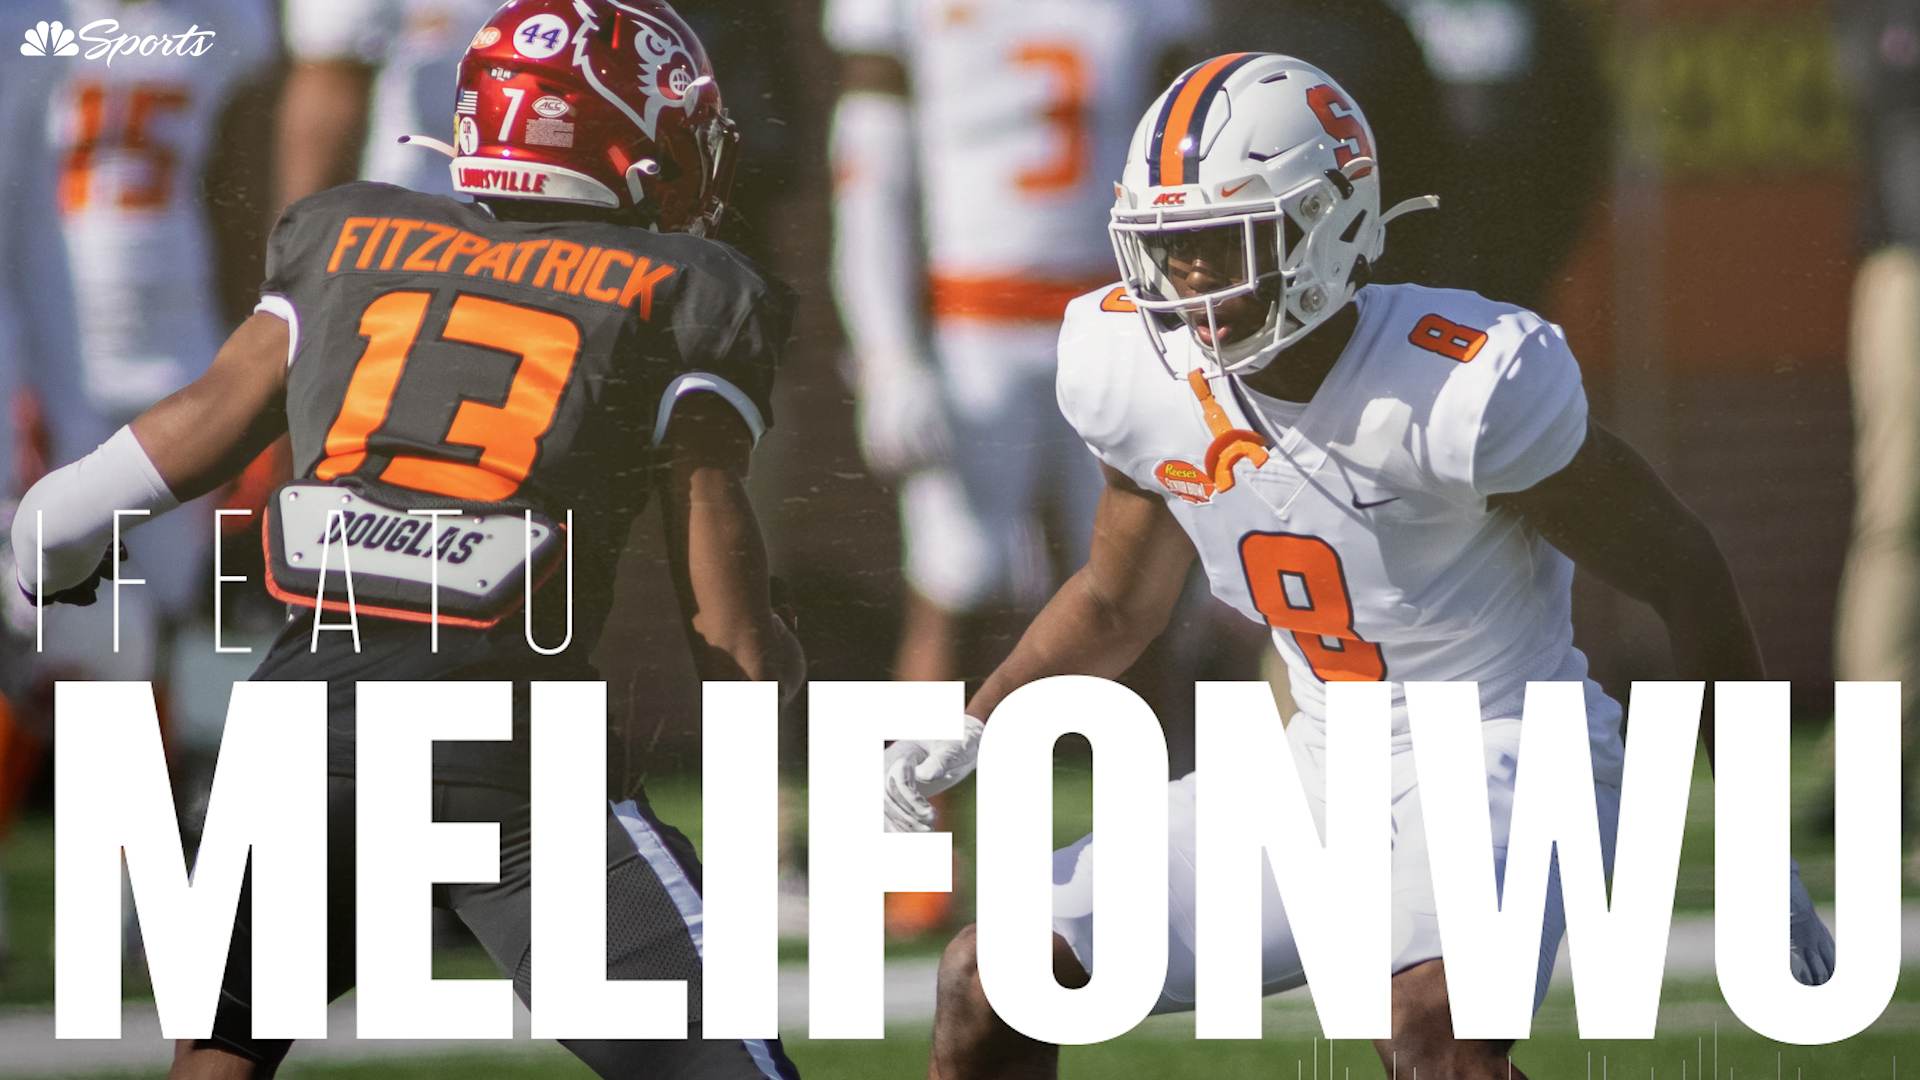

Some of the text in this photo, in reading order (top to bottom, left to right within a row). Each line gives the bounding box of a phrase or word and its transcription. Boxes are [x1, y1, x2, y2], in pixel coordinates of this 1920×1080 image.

[521, 23, 561, 51] 44
[498, 87, 525, 142] 7
[538, 101, 562, 111] ACC
[1008, 43, 1090, 197] 3
[458, 167, 547, 193] LOUISVILLE
[1152, 192, 1187, 206] ACC
[327, 217, 675, 322] FITZPATRICK
[1407, 312, 1489, 364] 8
[314, 287, 583, 504] 13
[1238, 530, 1388, 682] 8
